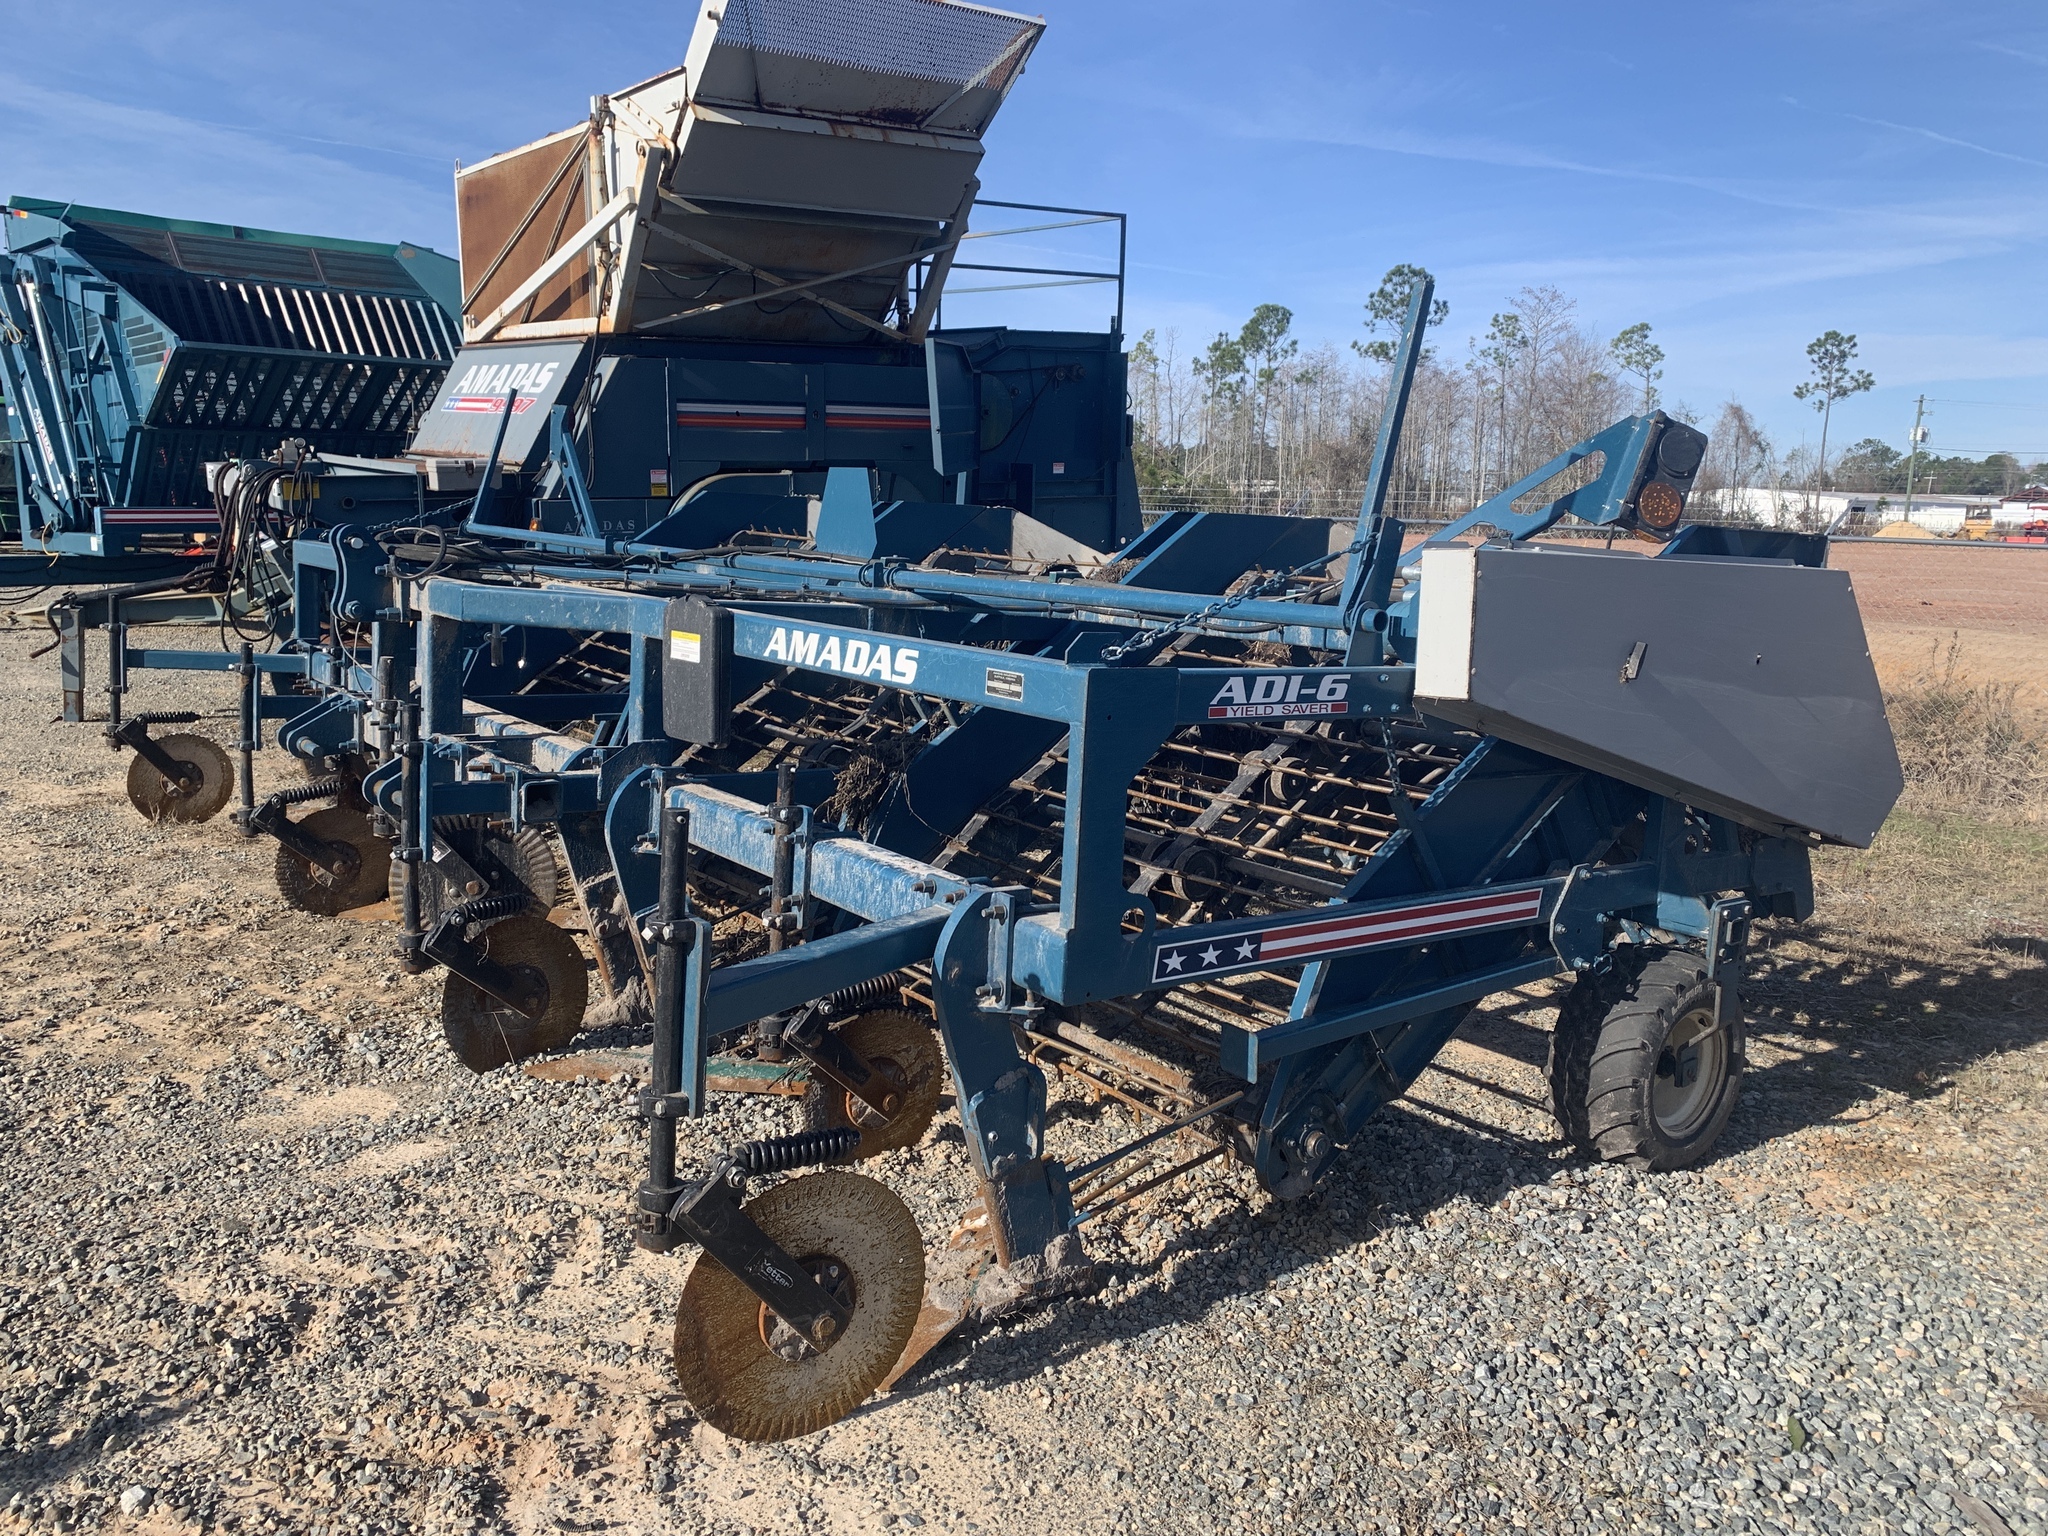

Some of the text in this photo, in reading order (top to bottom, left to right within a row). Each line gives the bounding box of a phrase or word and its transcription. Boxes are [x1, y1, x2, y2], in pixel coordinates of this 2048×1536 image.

[452, 362, 560, 394] AMADAS
[488, 397, 537, 414] 997
[563, 519, 636, 532] ADAS
[763, 627, 919, 685] AMADAS
[1209, 674, 1351, 705] ADI-6
[1230, 703, 1329, 716] YIELD SAVER
